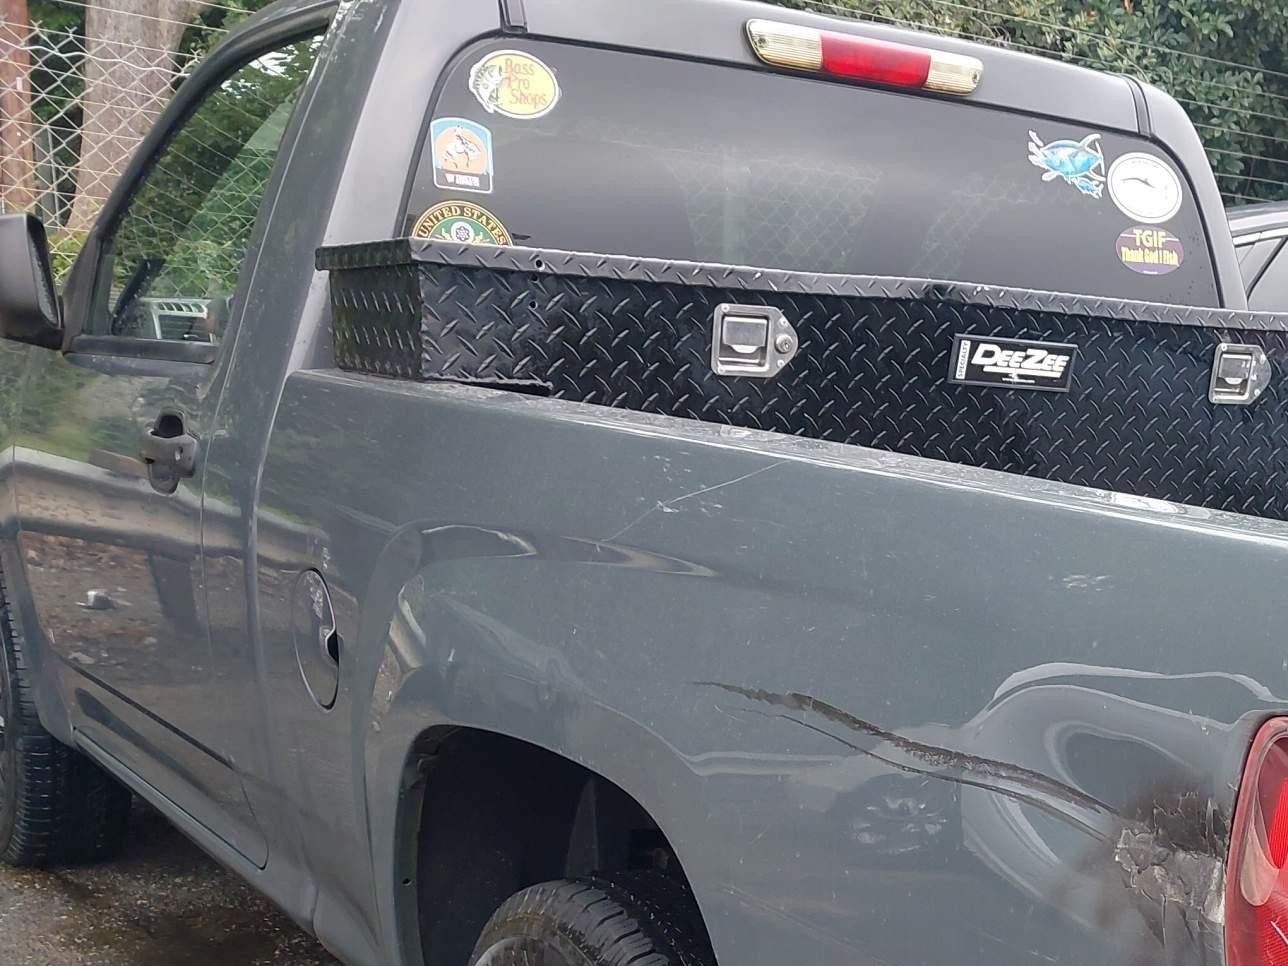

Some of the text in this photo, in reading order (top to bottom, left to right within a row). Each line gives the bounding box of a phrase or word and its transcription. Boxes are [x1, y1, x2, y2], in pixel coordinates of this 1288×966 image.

[504, 58, 534, 76] Bass
[503, 73, 530, 89] Pro
[509, 88, 547, 109] Shops
[418, 206, 507, 245] UNITED STATES
[1133, 229, 1167, 248] TGIF
[1121, 246, 1144, 262] Thank
[1144, 248, 1159, 264] God
[957, 341, 969, 377] SPECIALTY
